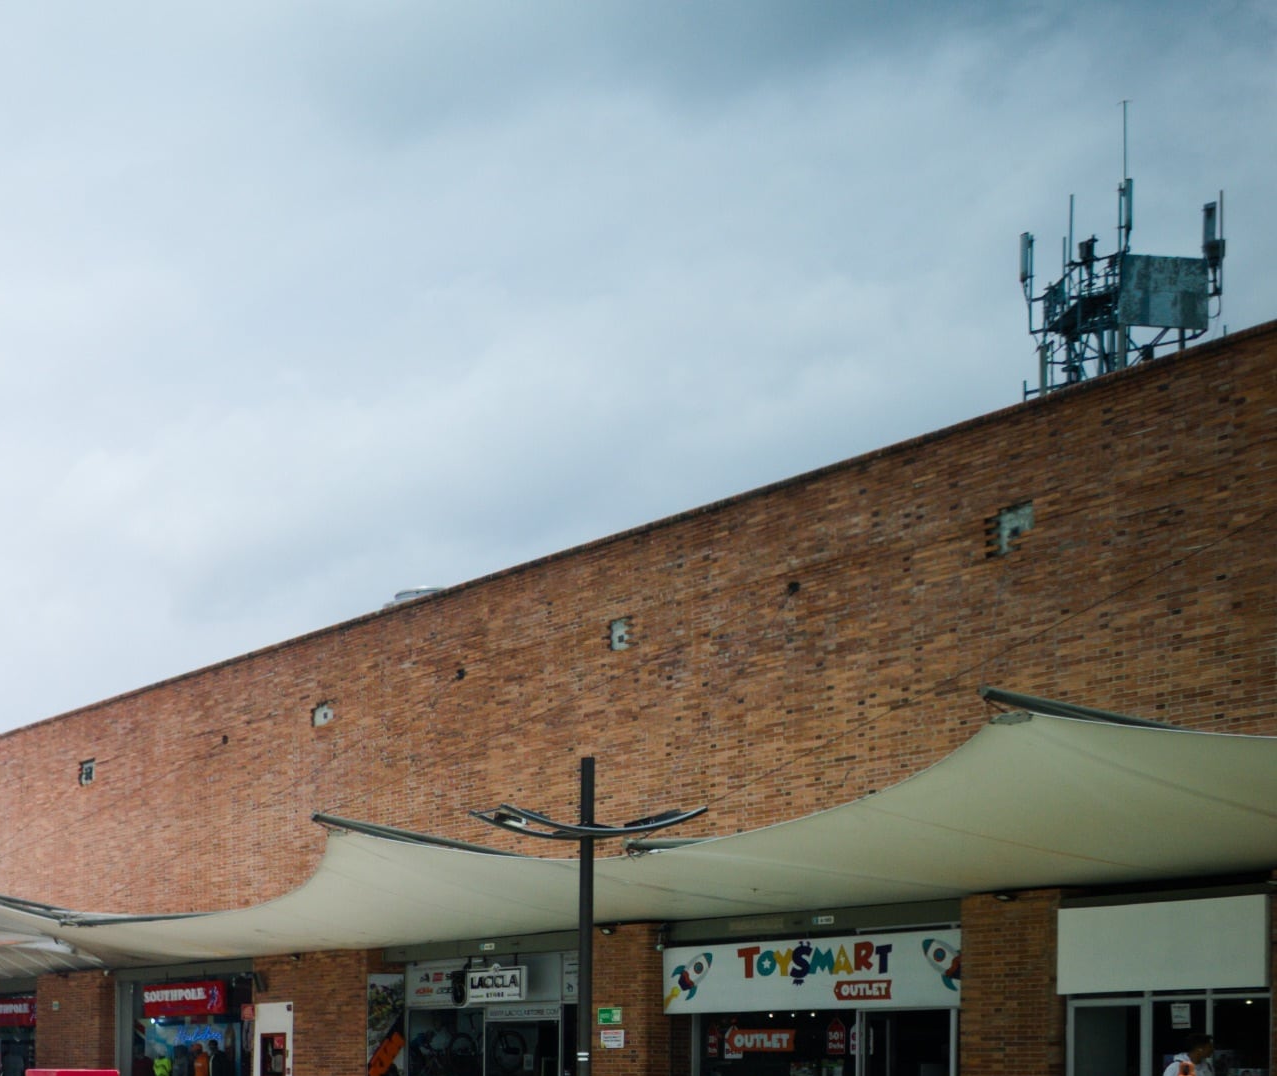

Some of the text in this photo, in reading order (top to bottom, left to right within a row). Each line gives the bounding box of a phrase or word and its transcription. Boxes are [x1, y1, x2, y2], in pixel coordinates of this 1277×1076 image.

[737, 941, 892, 985] TOYSMART
[143, 987, 206, 1003] SOUTHPOLE
[840, 983, 887, 996] OUTLET
[733, 1033, 789, 1049] OUTLET
